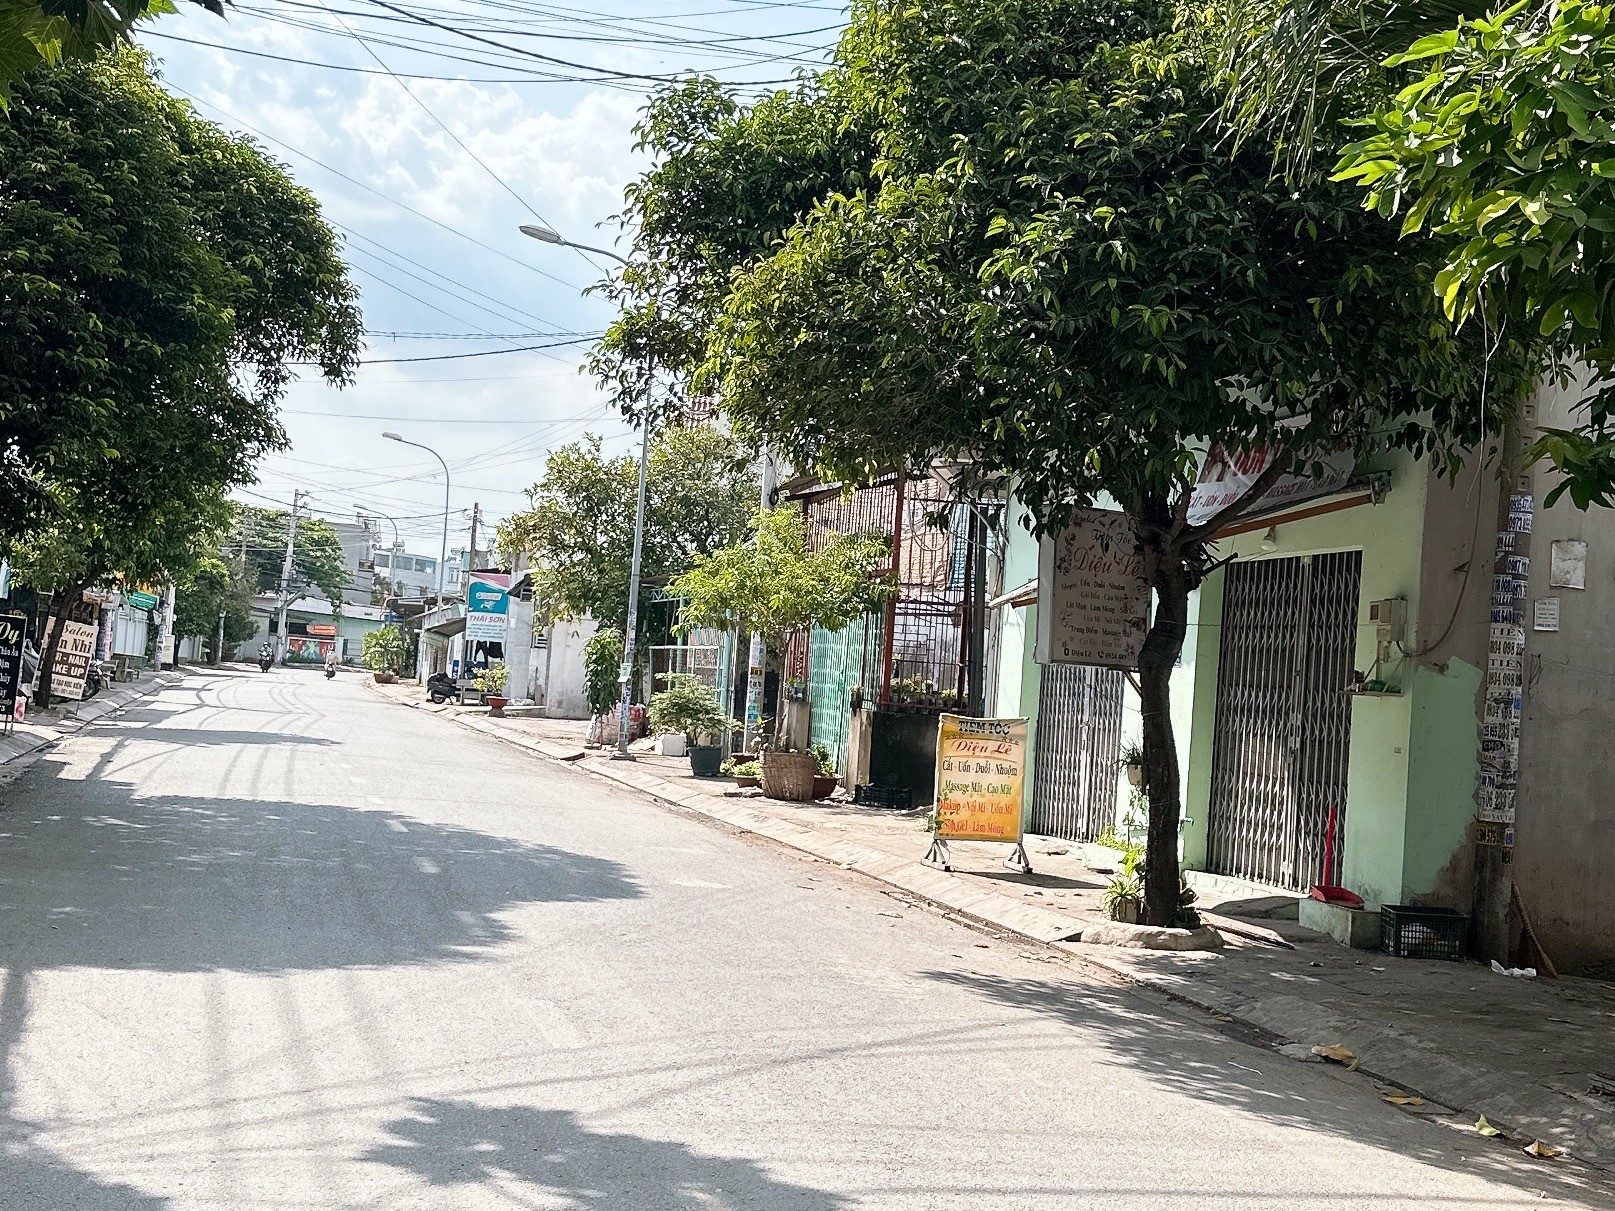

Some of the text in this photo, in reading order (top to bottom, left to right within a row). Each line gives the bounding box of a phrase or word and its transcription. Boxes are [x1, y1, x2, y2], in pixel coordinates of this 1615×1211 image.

[1073, 547, 1140, 577] Diệu Lê
[488, 615, 506, 623] SƠN
[64, 623, 94, 639] Salon
[71, 638, 93, 654] Nhi
[68, 654, 86, 667] NAIL
[70, 665, 85, 677] UP
[958, 719, 986, 735] TIỆM
[951, 739, 1012, 756] Diệu Lê
[942, 757, 1018, 779] Cắt Uốn Duỗi Nhuộm
[945, 780, 970, 795] Massage
